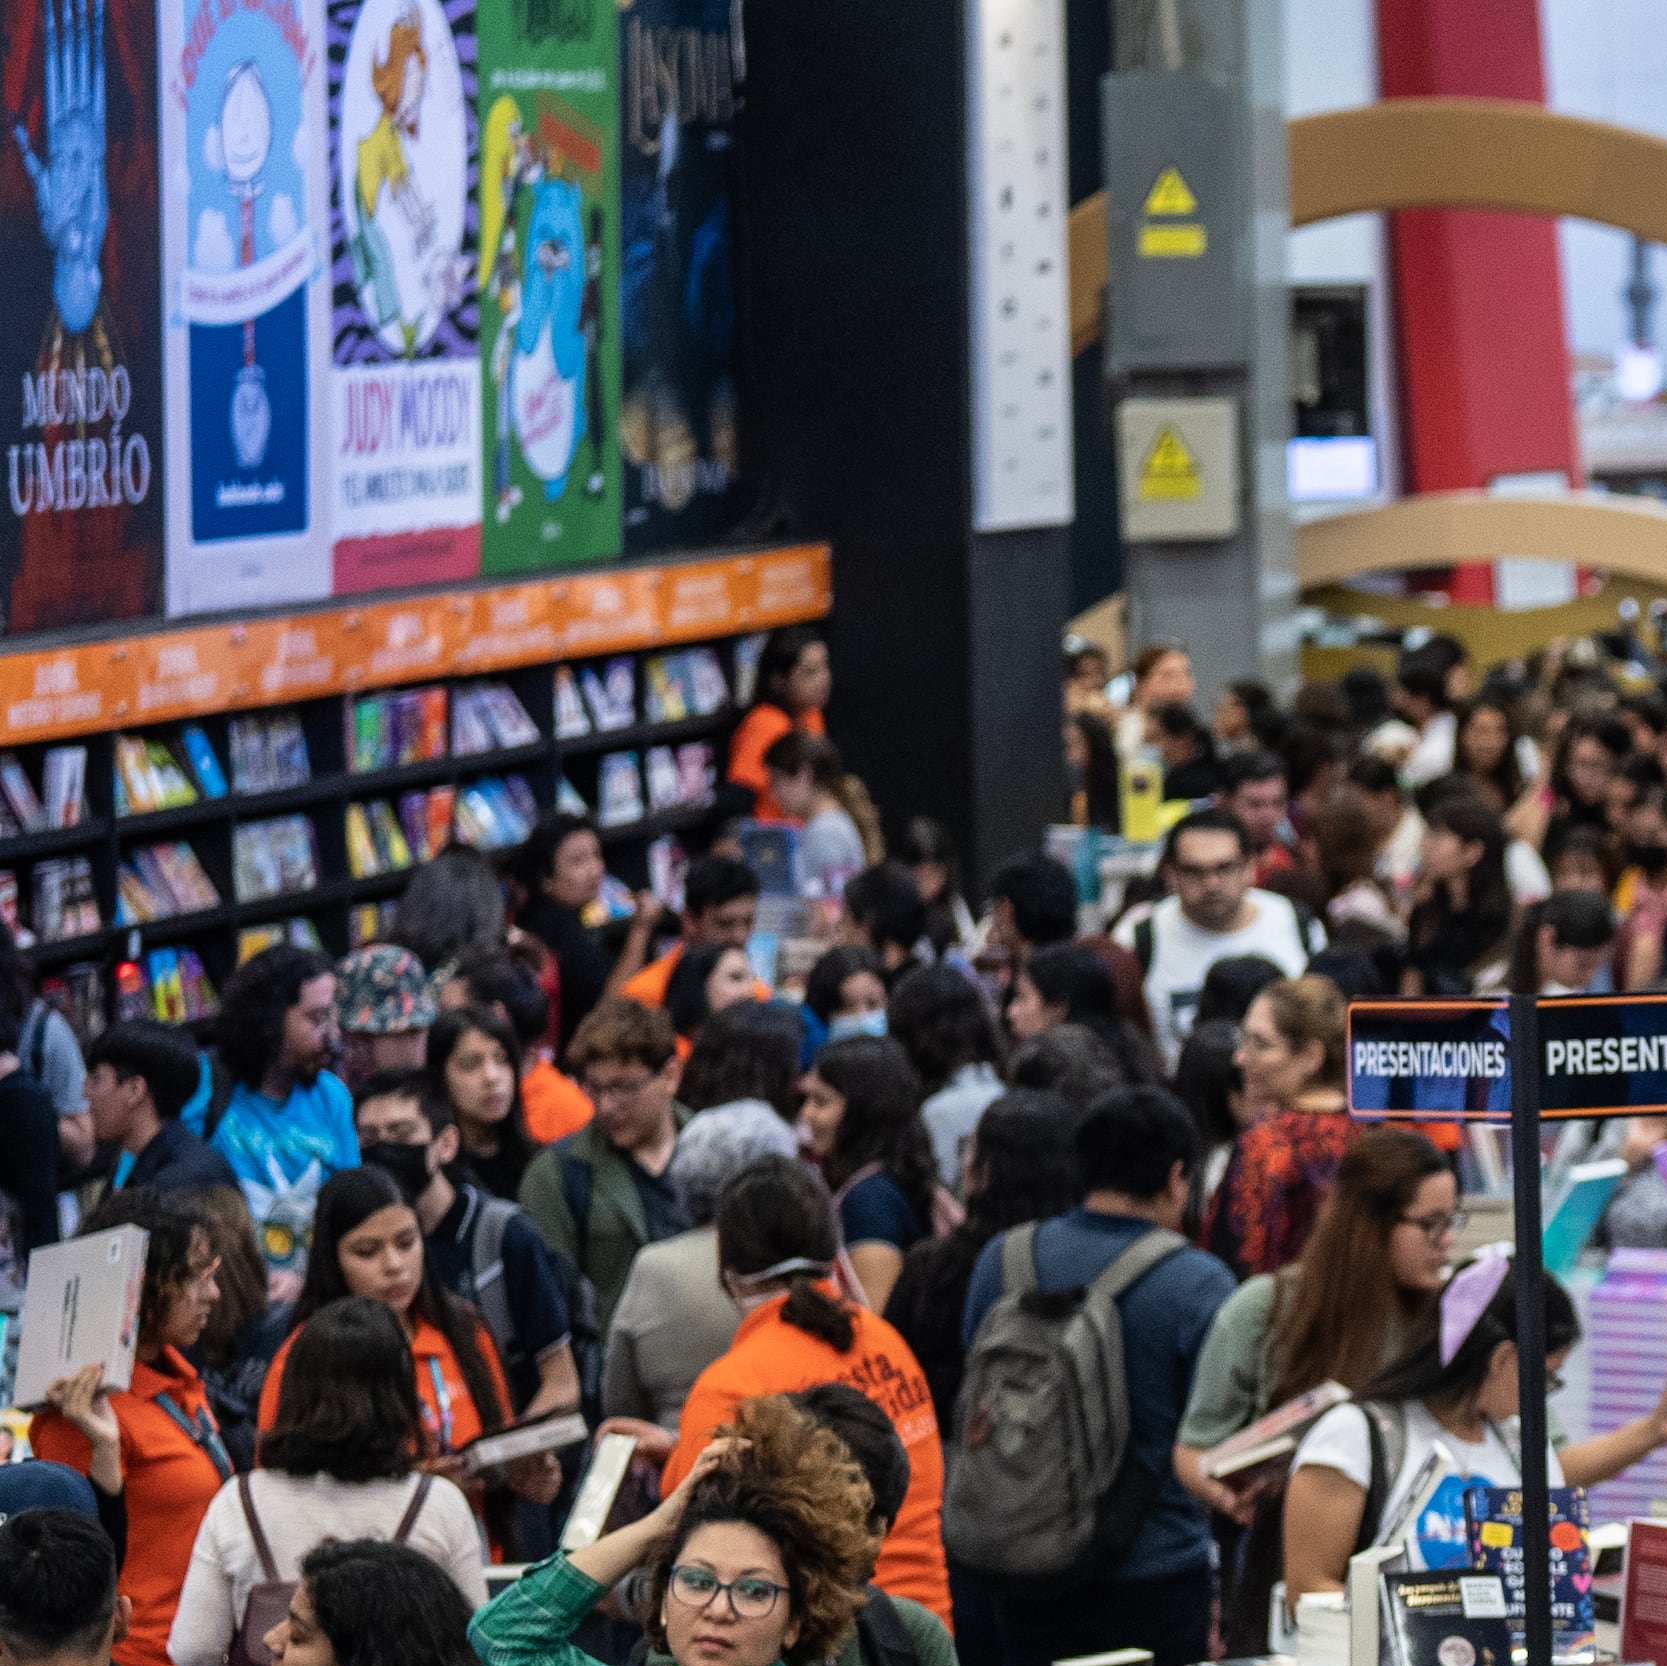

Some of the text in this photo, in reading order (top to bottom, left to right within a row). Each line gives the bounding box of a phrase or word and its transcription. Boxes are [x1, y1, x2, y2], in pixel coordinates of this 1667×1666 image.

[21, 366, 131, 430] MUNDO
[7, 424, 151, 516] UMBRÍO
[1354, 1041, 1506, 1079] PRESENTACIONES
